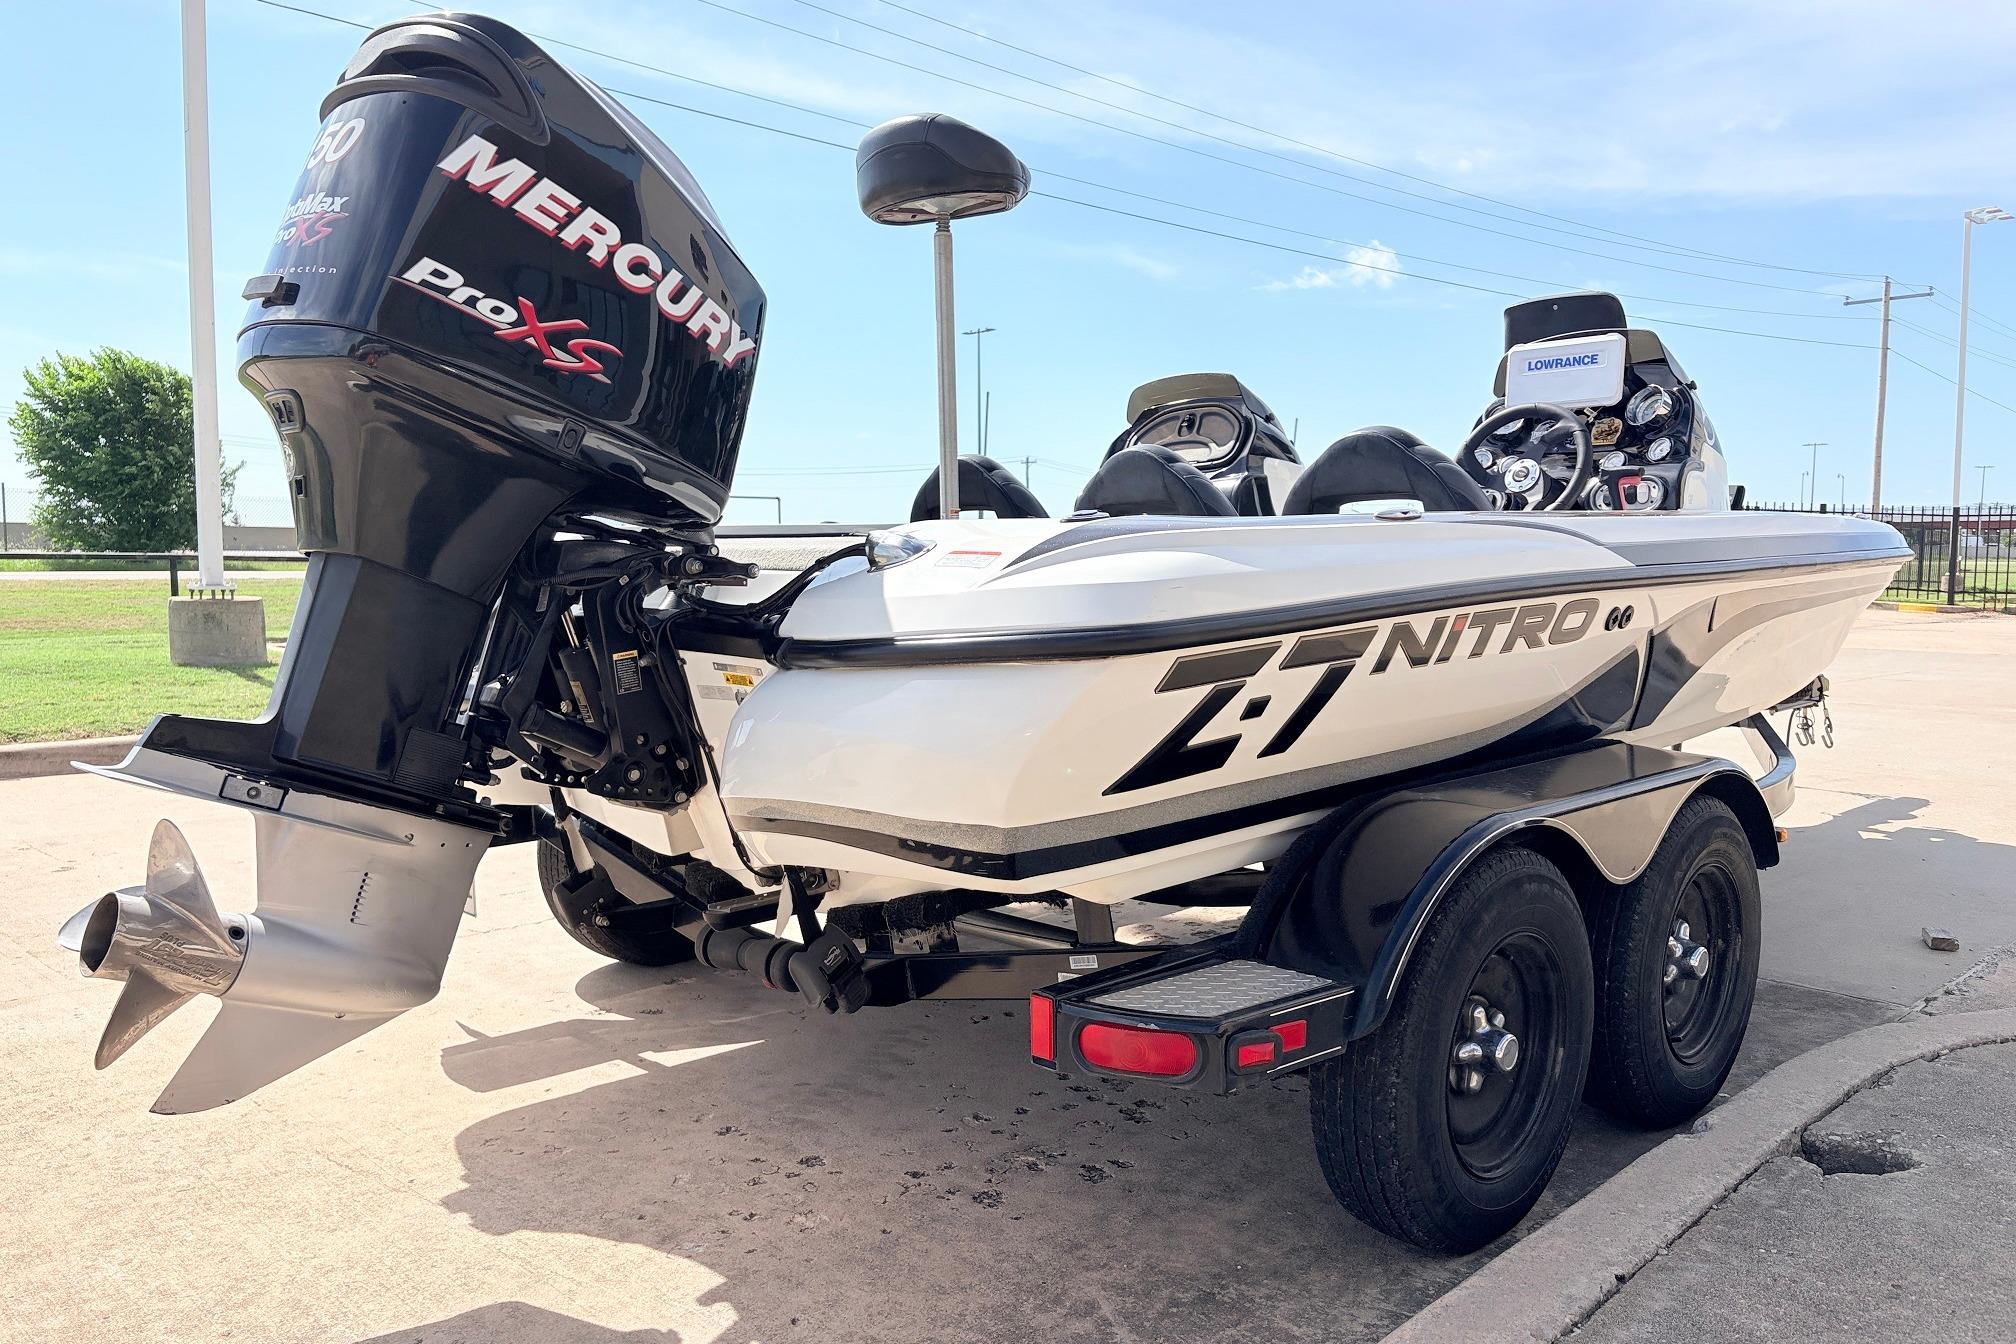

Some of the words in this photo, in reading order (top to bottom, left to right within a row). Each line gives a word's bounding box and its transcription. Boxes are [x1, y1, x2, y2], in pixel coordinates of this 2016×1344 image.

[436, 134, 756, 368] MERCURY
[1527, 353, 1599, 372] LOWRANCE
[1369, 598, 1600, 676] NITRO
